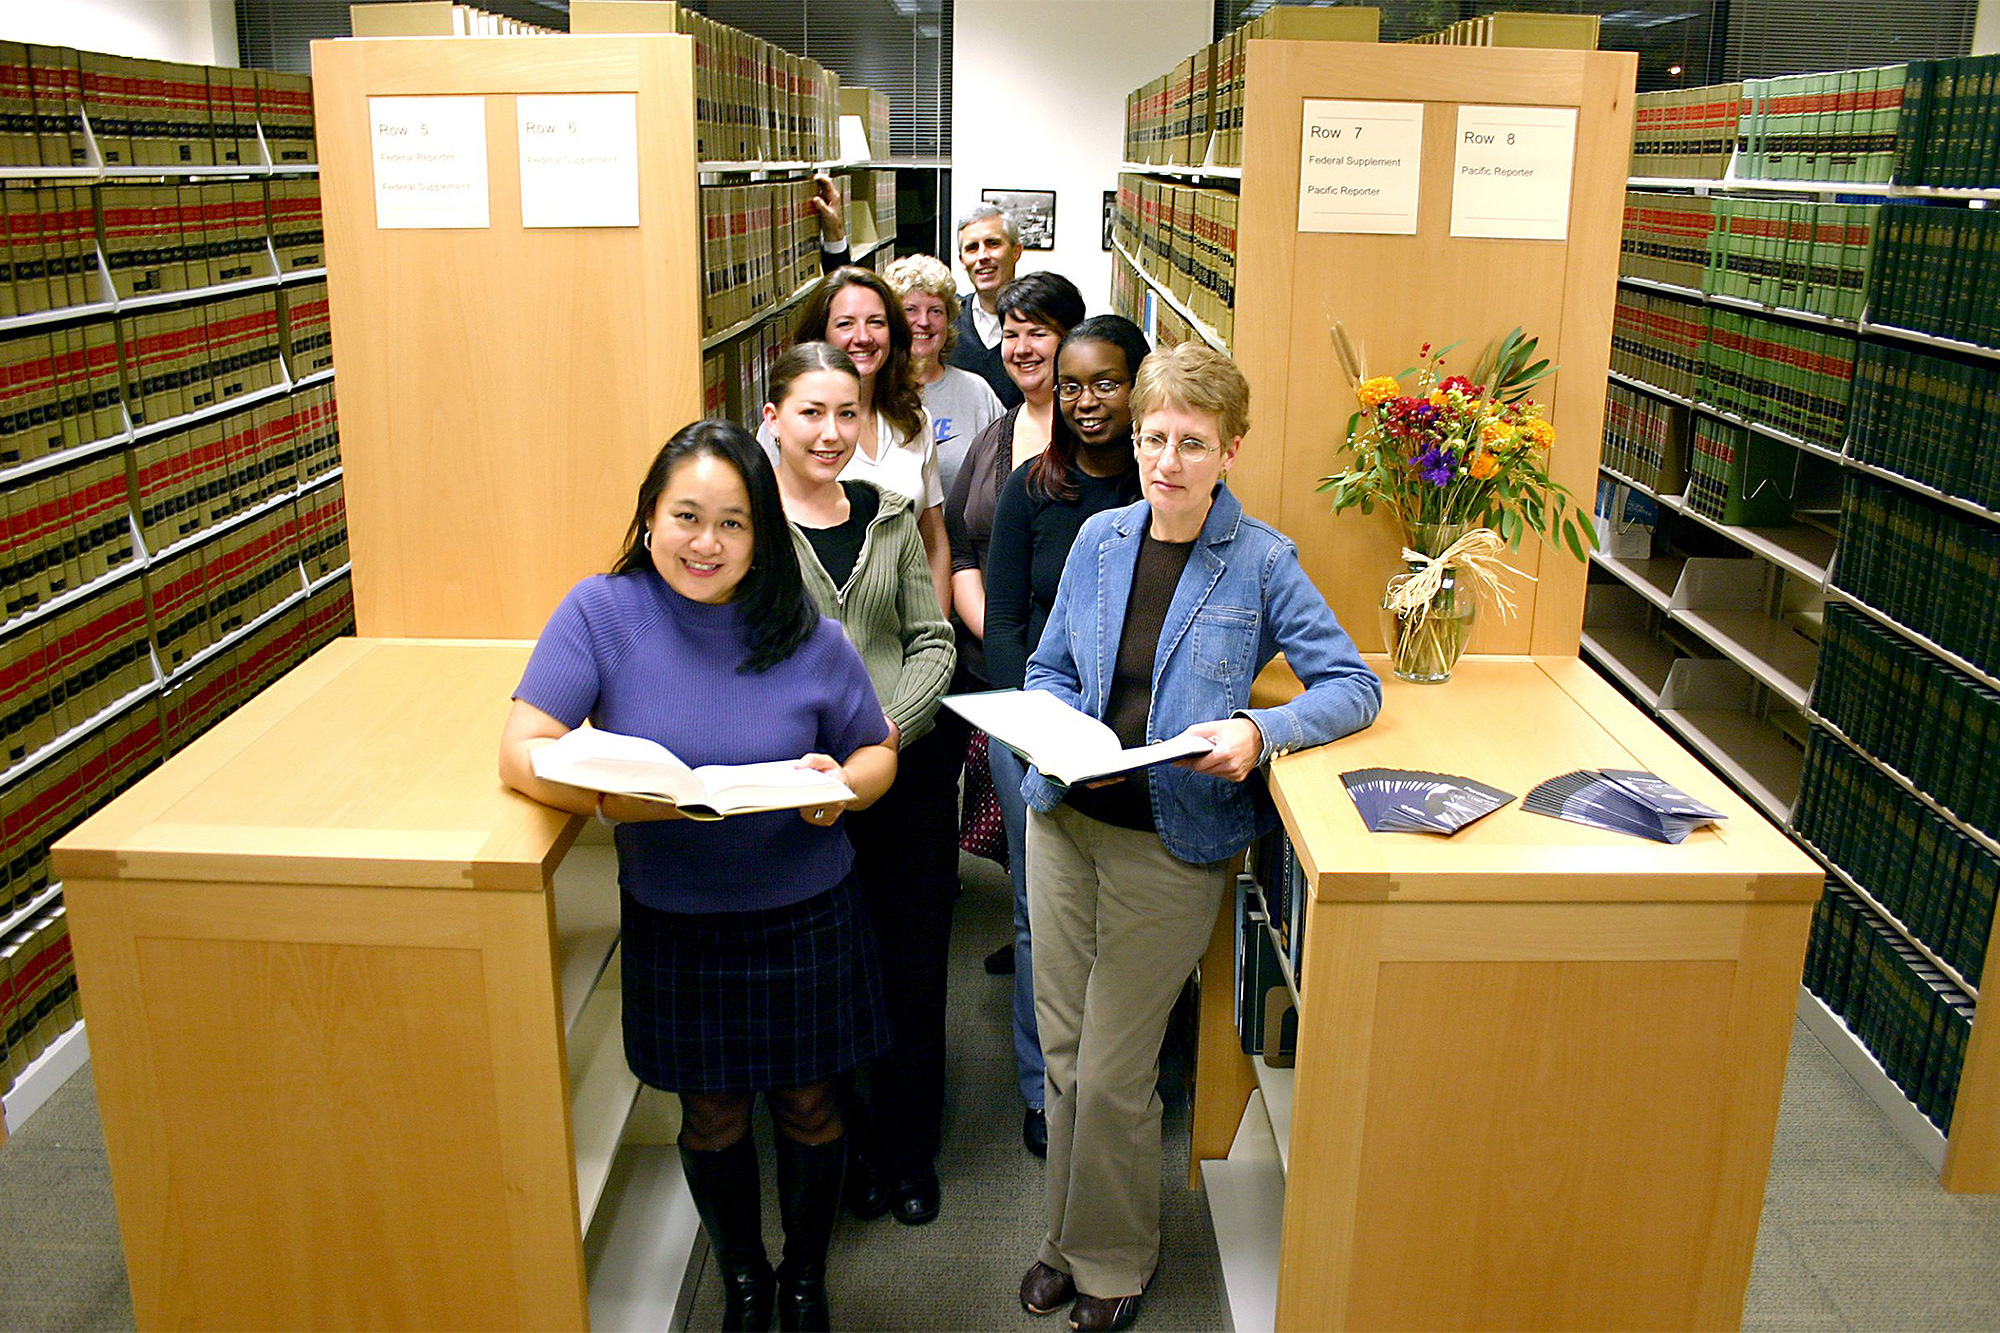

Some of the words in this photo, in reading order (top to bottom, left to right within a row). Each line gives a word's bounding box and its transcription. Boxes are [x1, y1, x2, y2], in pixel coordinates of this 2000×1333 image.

[379, 124, 408, 136] Row
[421, 123, 430, 136] 5
[526, 121, 556, 134] Row
[568, 121, 577, 134] 6
[1310, 125, 1341, 139] Row
[1354, 127, 1363, 139] 7
[1464, 131, 1495, 145] Row
[1507, 133, 1516, 146] 8
[1309, 155, 1344, 166] Federal
[1346, 156, 1401, 168] Supplement
[1462, 166, 1492, 176] Pacific
[1494, 167, 1534, 178] Reporter
[1307, 185, 1338, 195] Pacific
[1340, 186, 1381, 197] Reporter
